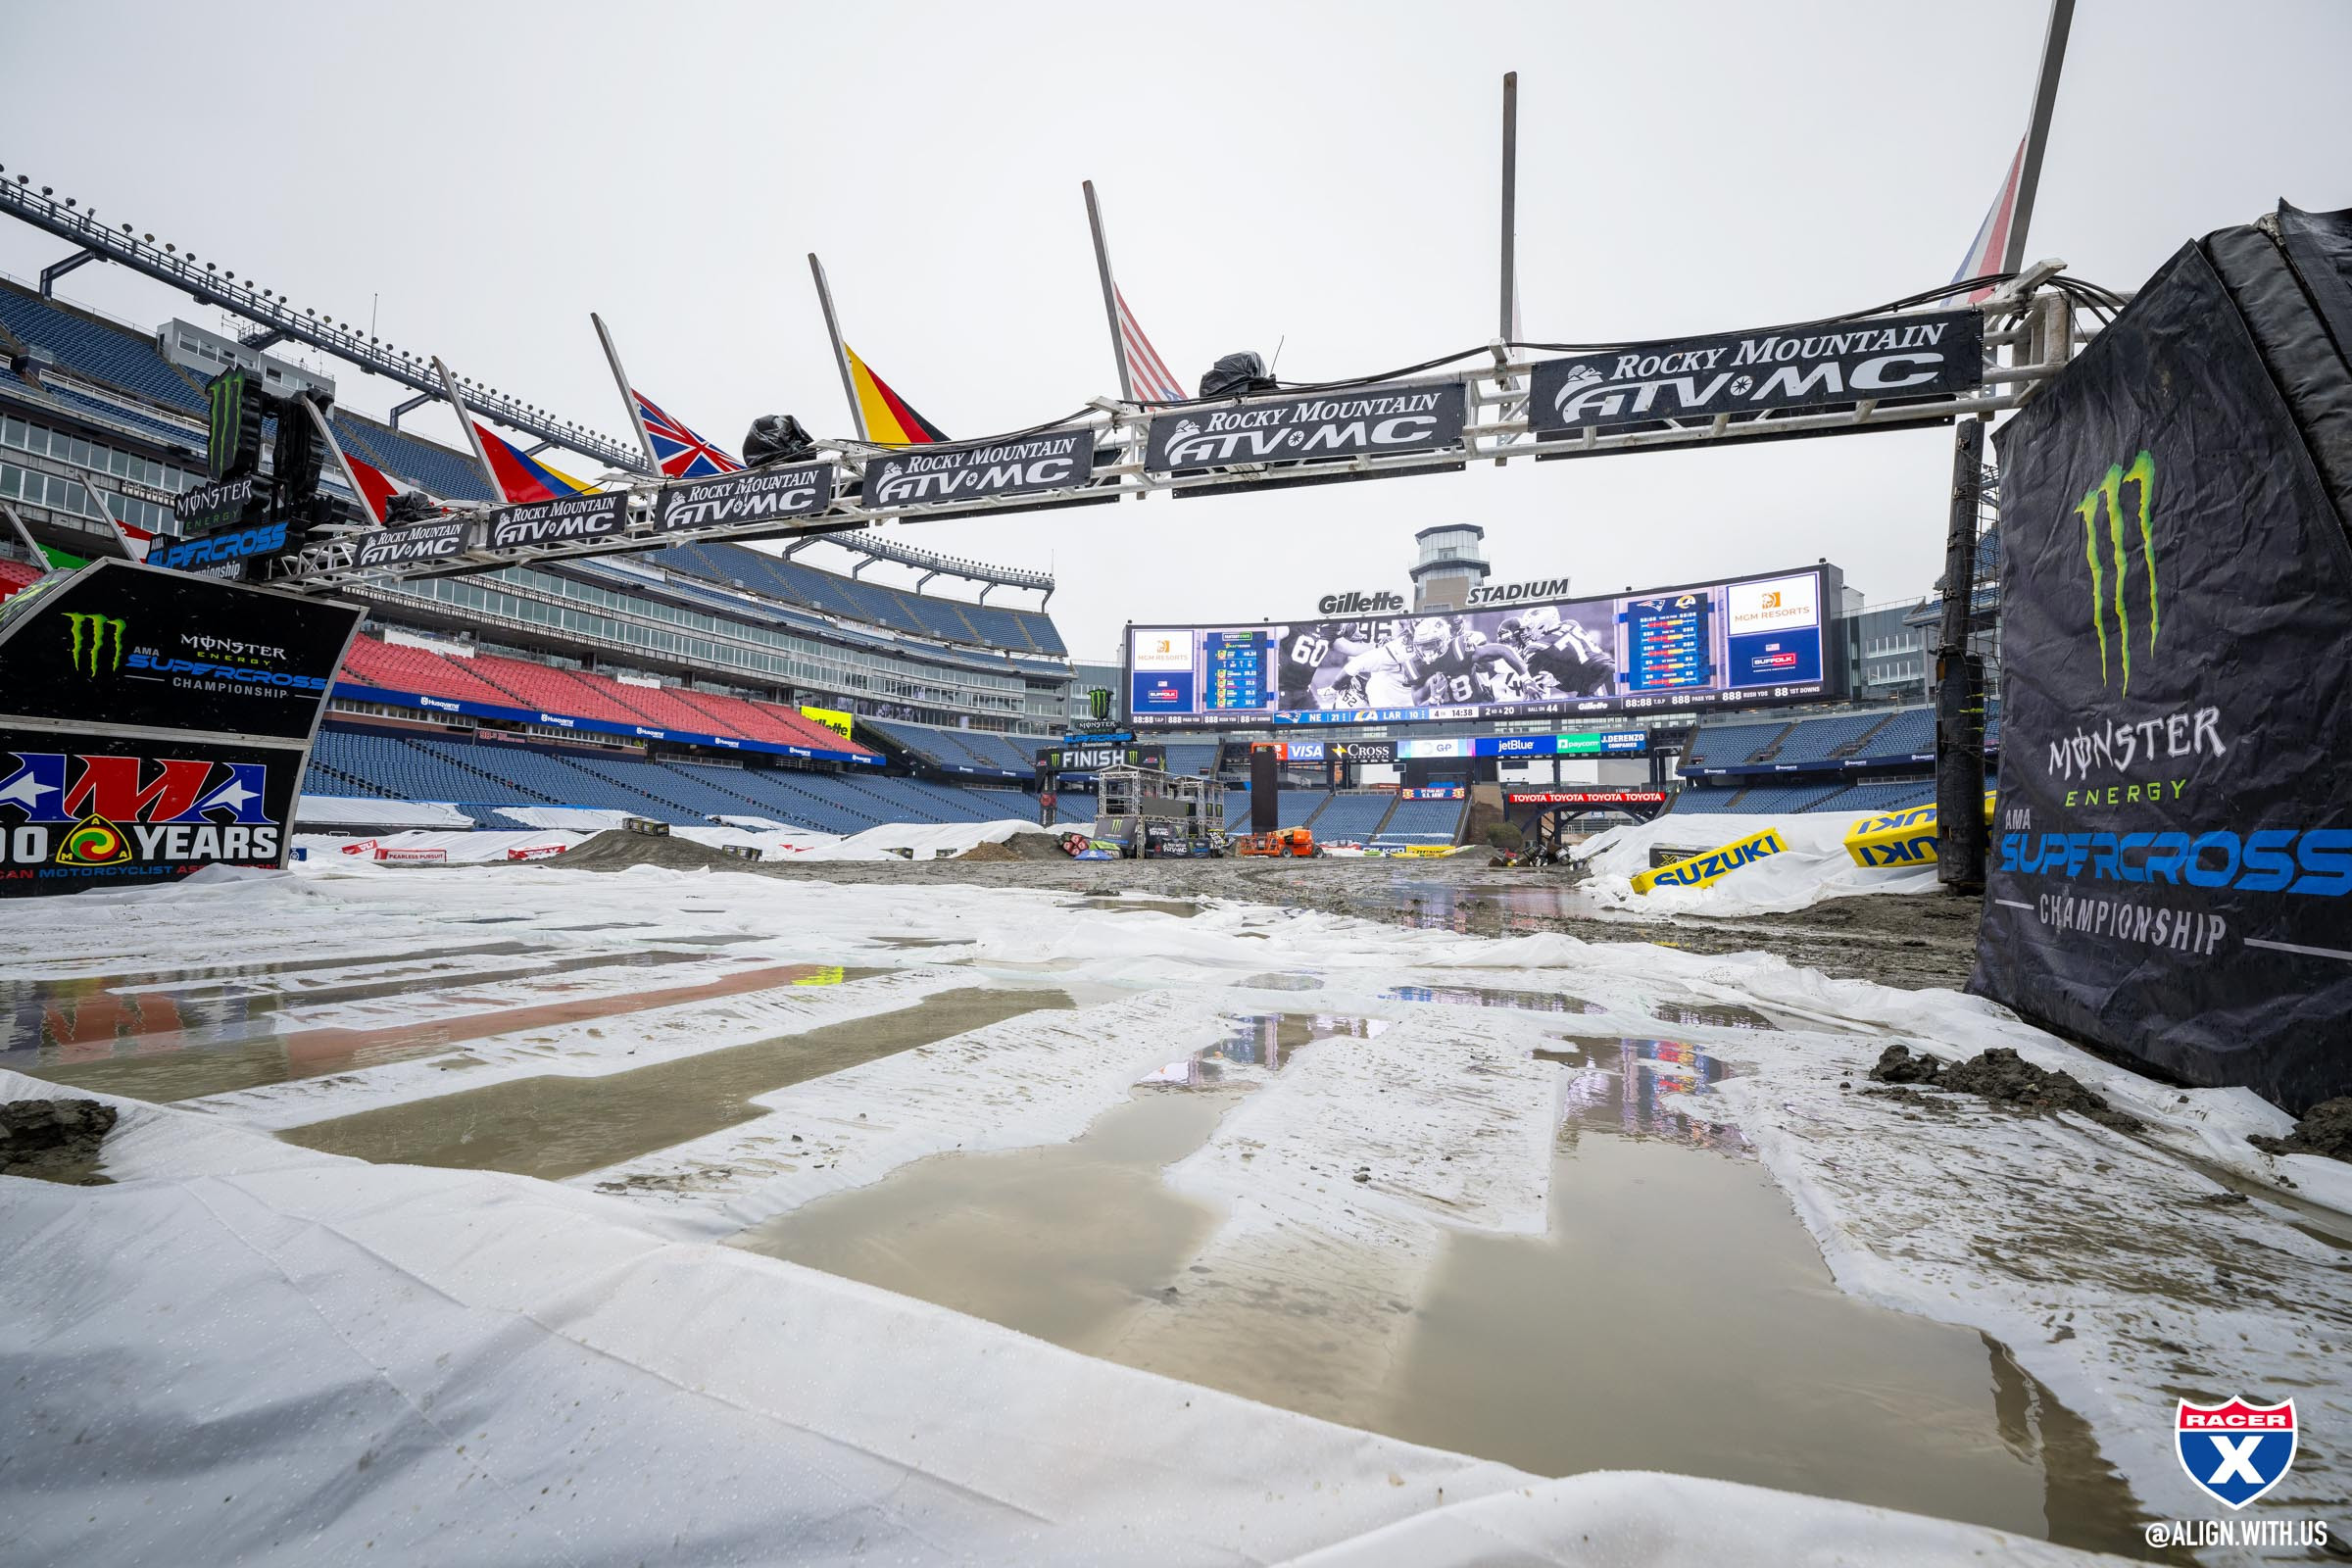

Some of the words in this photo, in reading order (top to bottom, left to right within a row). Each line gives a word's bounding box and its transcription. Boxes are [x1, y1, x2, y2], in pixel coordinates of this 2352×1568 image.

[1610, 348, 1728, 381] ROCKY
[1730, 322, 1948, 367] MOUNTAIN
[1205, 409, 1289, 432] ROCKY
[1290, 393, 1442, 423] MOUNTAIN
[906, 453, 966, 473] ROCKY
[967, 438, 1077, 466] MOUNTAIN
[688, 483, 734, 503] ROCKY
[735, 470, 819, 495] MOUNTAIN
[176, 479, 252, 517] MONSTER
[185, 510, 238, 531] ENERGY
[512, 506, 549, 522] ROCKY
[549, 497, 617, 516] MOUNTAIN
[147, 521, 289, 568] SUPERCROSS
[377, 531, 409, 545] ROCKY
[408, 524, 464, 541] MOUNTAIN
[1467, 578, 1569, 605] STADIUM
[1318, 591, 1404, 615] Gillette
[1735, 612, 1758, 622] MGM
[1761, 607, 1810, 618] RESORTS
[133, 646, 160, 658] AMA
[180, 633, 287, 661] MONSTER
[1291, 635, 1329, 667] 60
[197, 651, 270, 666] ENERGY
[125, 654, 329, 690] SUPERCROSS
[172, 676, 287, 699] CHAMPIONSHIP
[1722, 691, 1741, 701] 888
[1775, 688, 1788, 697] 88
[1578, 702, 1608, 710] Gillette
[1626, 697, 1652, 708] 88:88
[1672, 695, 1690, 705] 888
[1079, 720, 1116, 729] MONSTER
[1383, 711, 1401, 720] LAR
[1498, 740, 1535, 753] jetBlue
[1601, 733, 1644, 744] J.DERENZO
[2048, 706, 2226, 780] MONSTER
[1062, 750, 1126, 767] FINISH
[1290, 745, 1323, 758] VISA
[1347, 743, 1390, 757] CROSS
[1587, 793, 1622, 802] TOYOTA
[2065, 779, 2186, 808] ENERGY
[2005, 808, 2031, 830] AMA
[0, 826, 48, 863] 0
[133, 825, 278, 860] YEARS
[39, 864, 172, 879] MOTORCYCLIST
[1653, 835, 1781, 886] SUZUKI
[2000, 828, 2352, 897] SUPERCROSS
[2039, 893, 2227, 956] CHAMPIONSHIP
